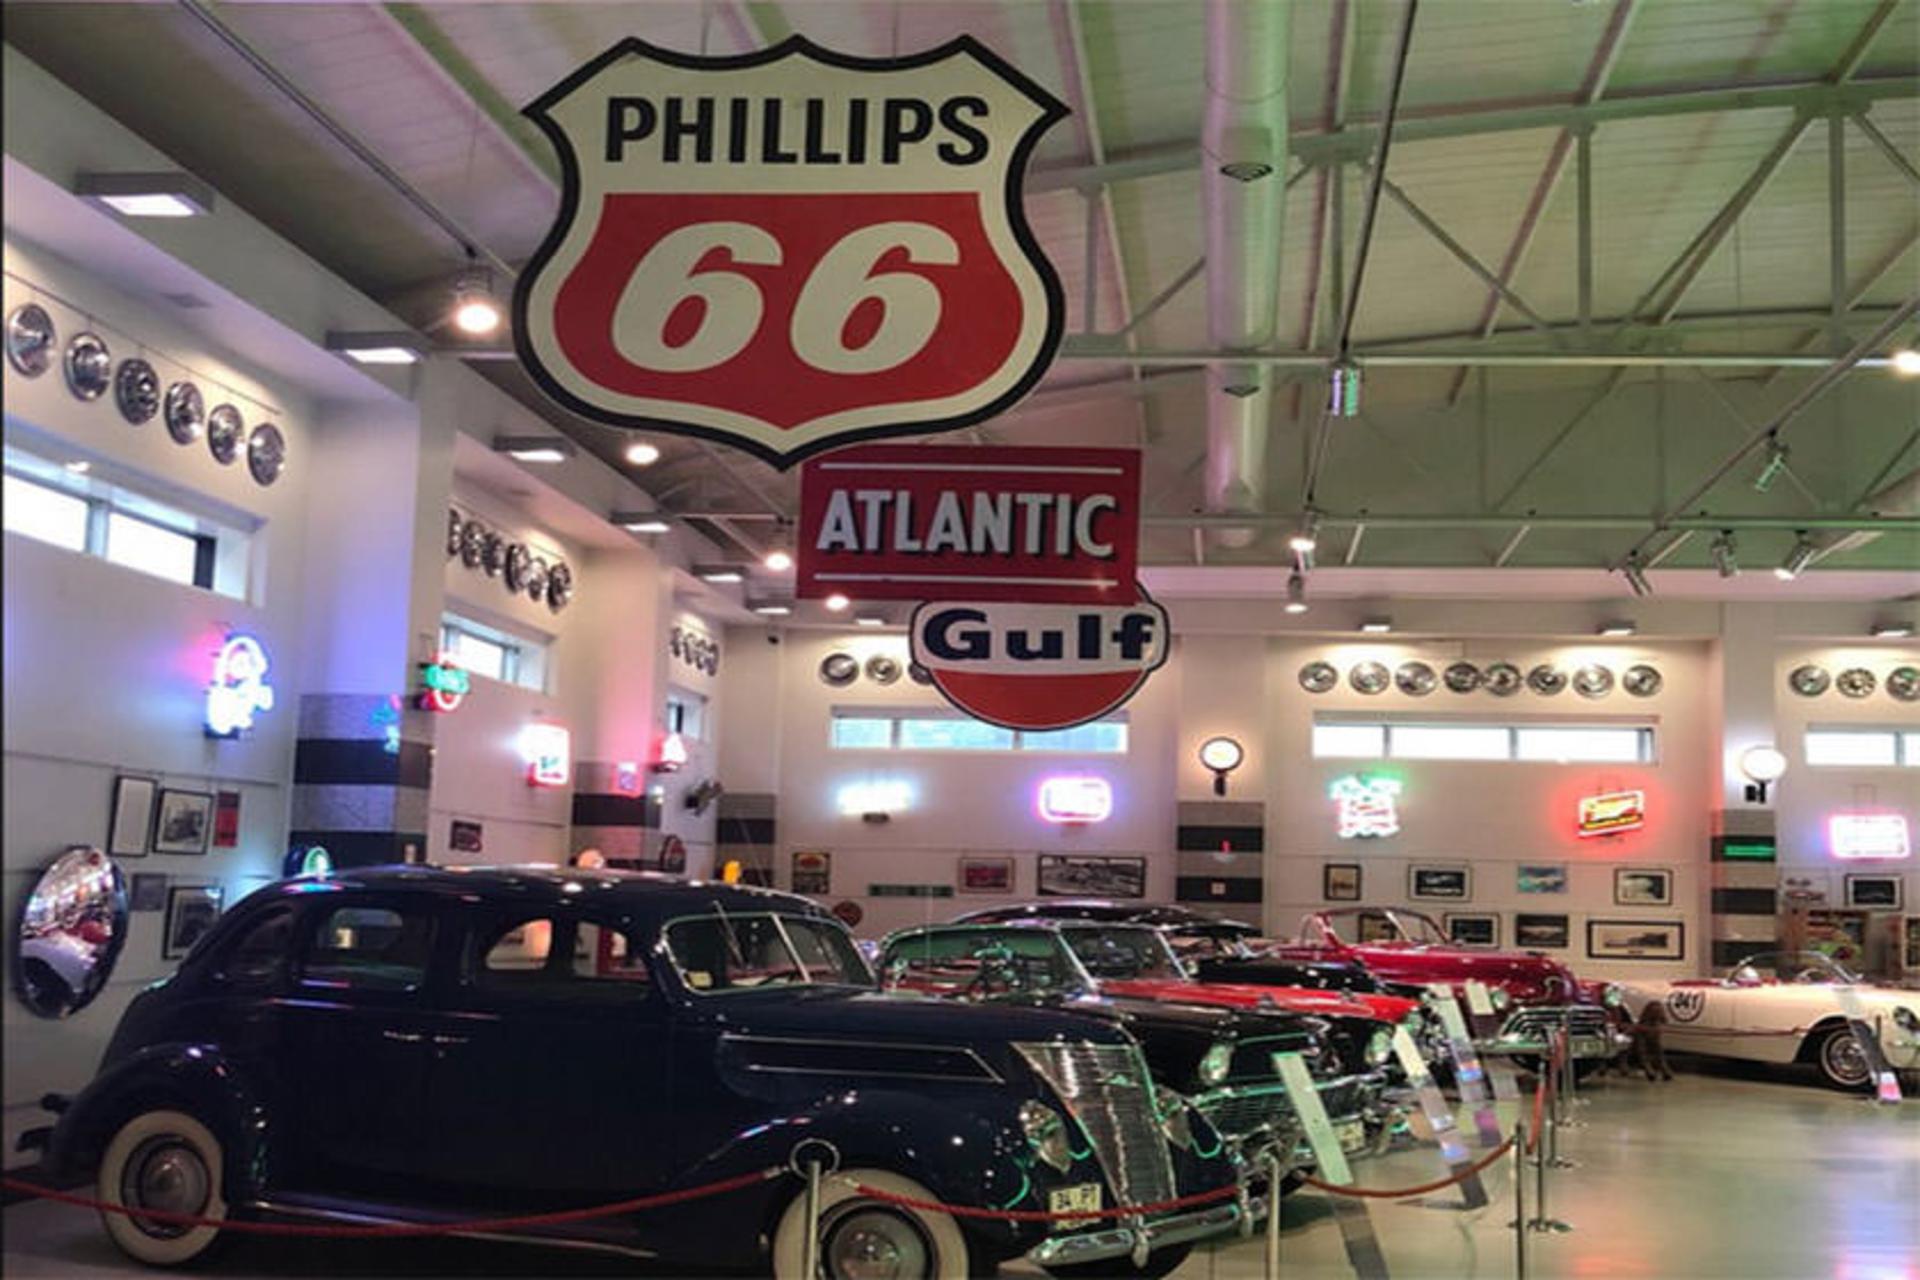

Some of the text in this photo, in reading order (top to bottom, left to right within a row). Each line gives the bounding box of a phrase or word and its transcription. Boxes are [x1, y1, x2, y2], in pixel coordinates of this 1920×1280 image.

[605, 96, 989, 165] PHILLIPS
[612, 221, 961, 375] 66
[816, 489, 1117, 559] ATLANTIC
[923, 608, 1156, 661] Gulf
